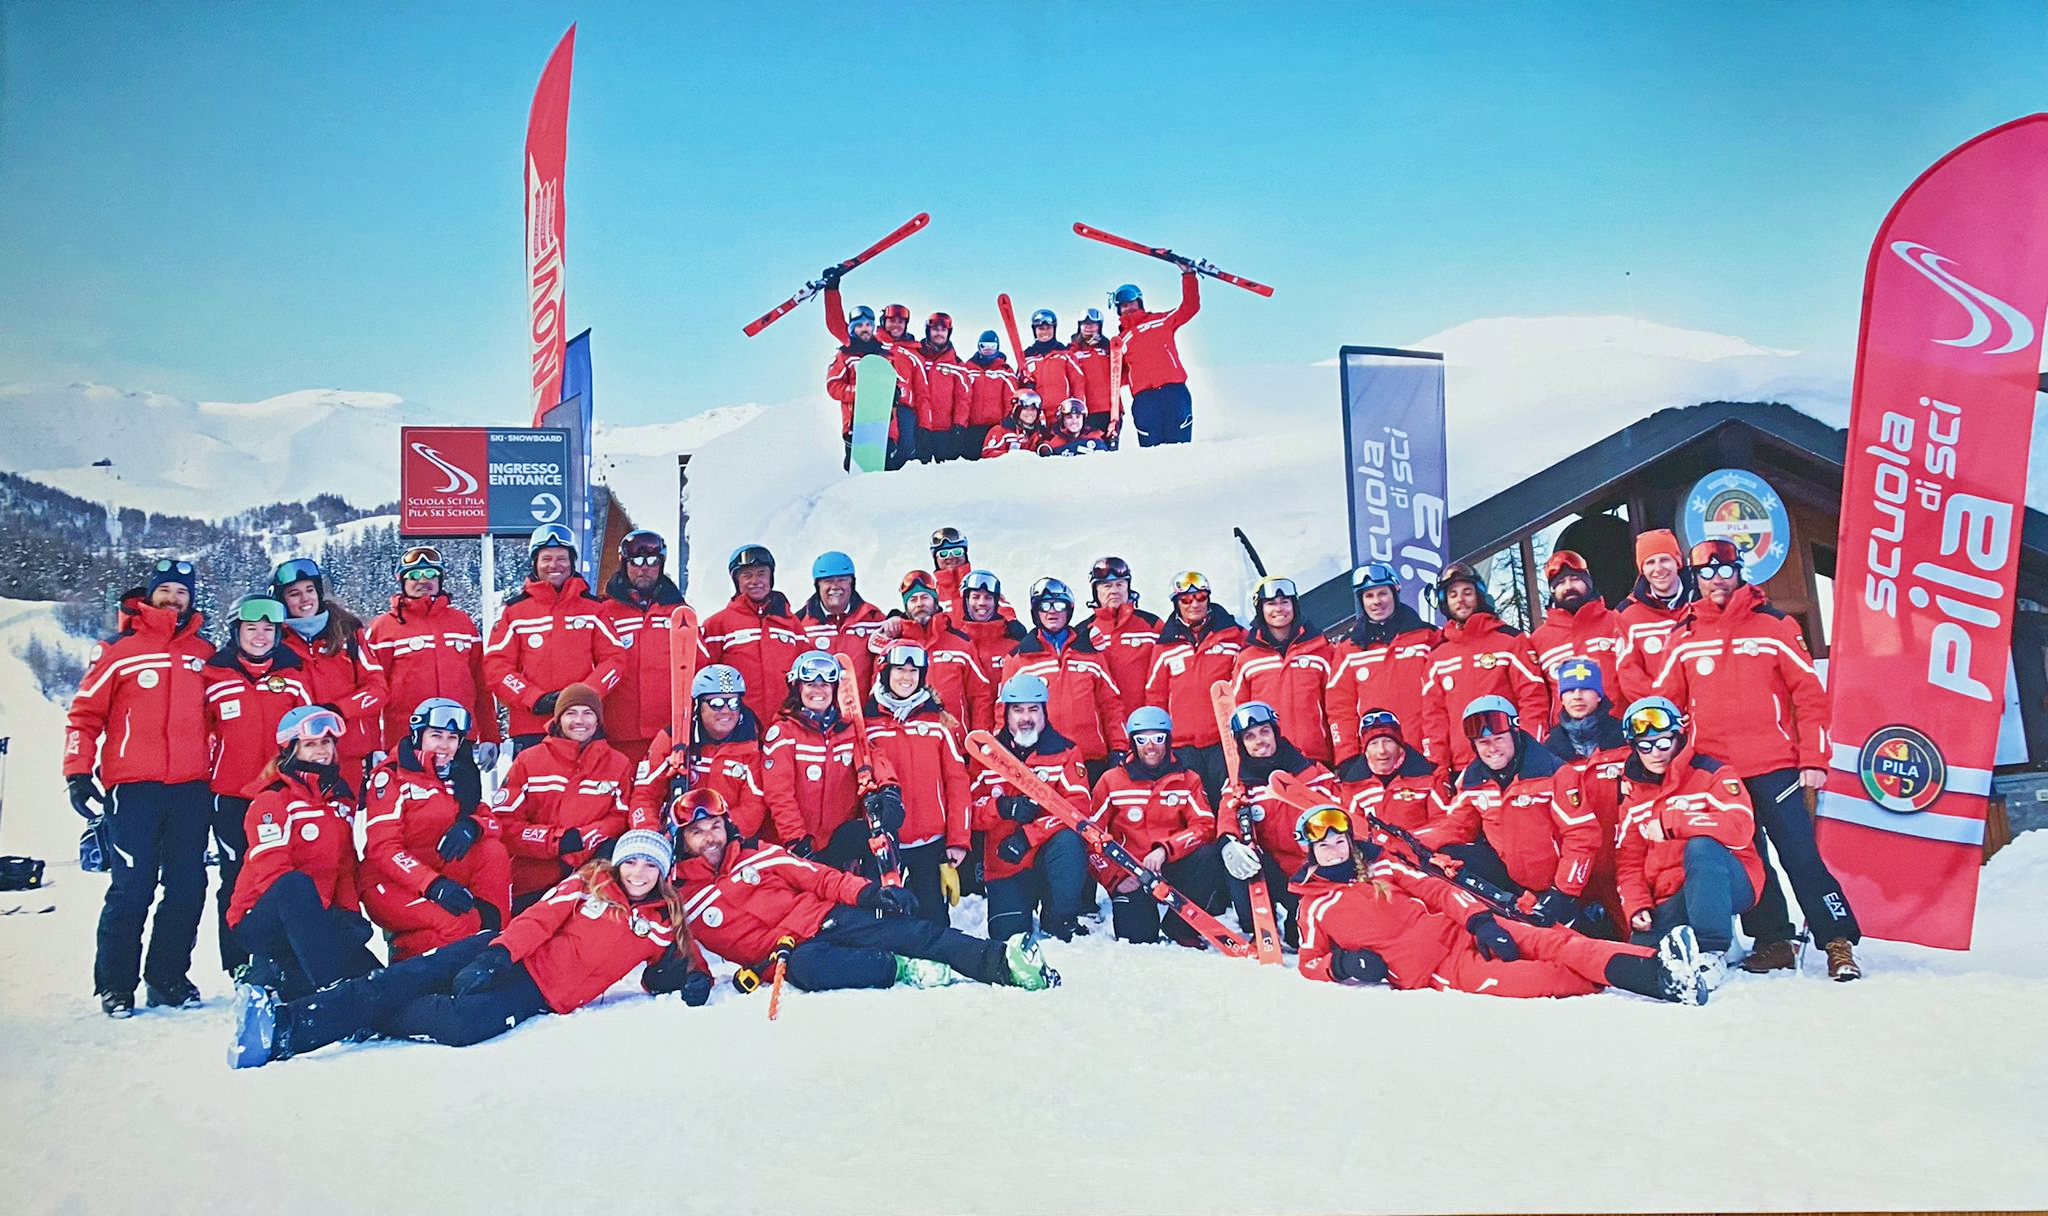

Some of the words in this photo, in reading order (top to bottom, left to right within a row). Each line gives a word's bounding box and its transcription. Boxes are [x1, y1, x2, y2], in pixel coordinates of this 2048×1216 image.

[1919, 396, 1962, 480] sci
[1384, 426, 1413, 485] sci
[489, 463, 559, 474] INGRESSO
[489, 474, 562, 485] ENTRANCE
[1358, 440, 1393, 562] cuola
[1390, 487, 1408, 509] di
[1914, 478, 1942, 511] di
[1864, 410, 1915, 619] scuola
[1727, 523, 1749, 531] PILA
[1908, 493, 2013, 702] pila
[502, 673, 526, 691] EA7
[1882, 759, 1919, 778] PILA
[522, 827, 548, 840] EA7
[393, 851, 419, 870] EA7
[1827, 891, 1847, 917] EA7
